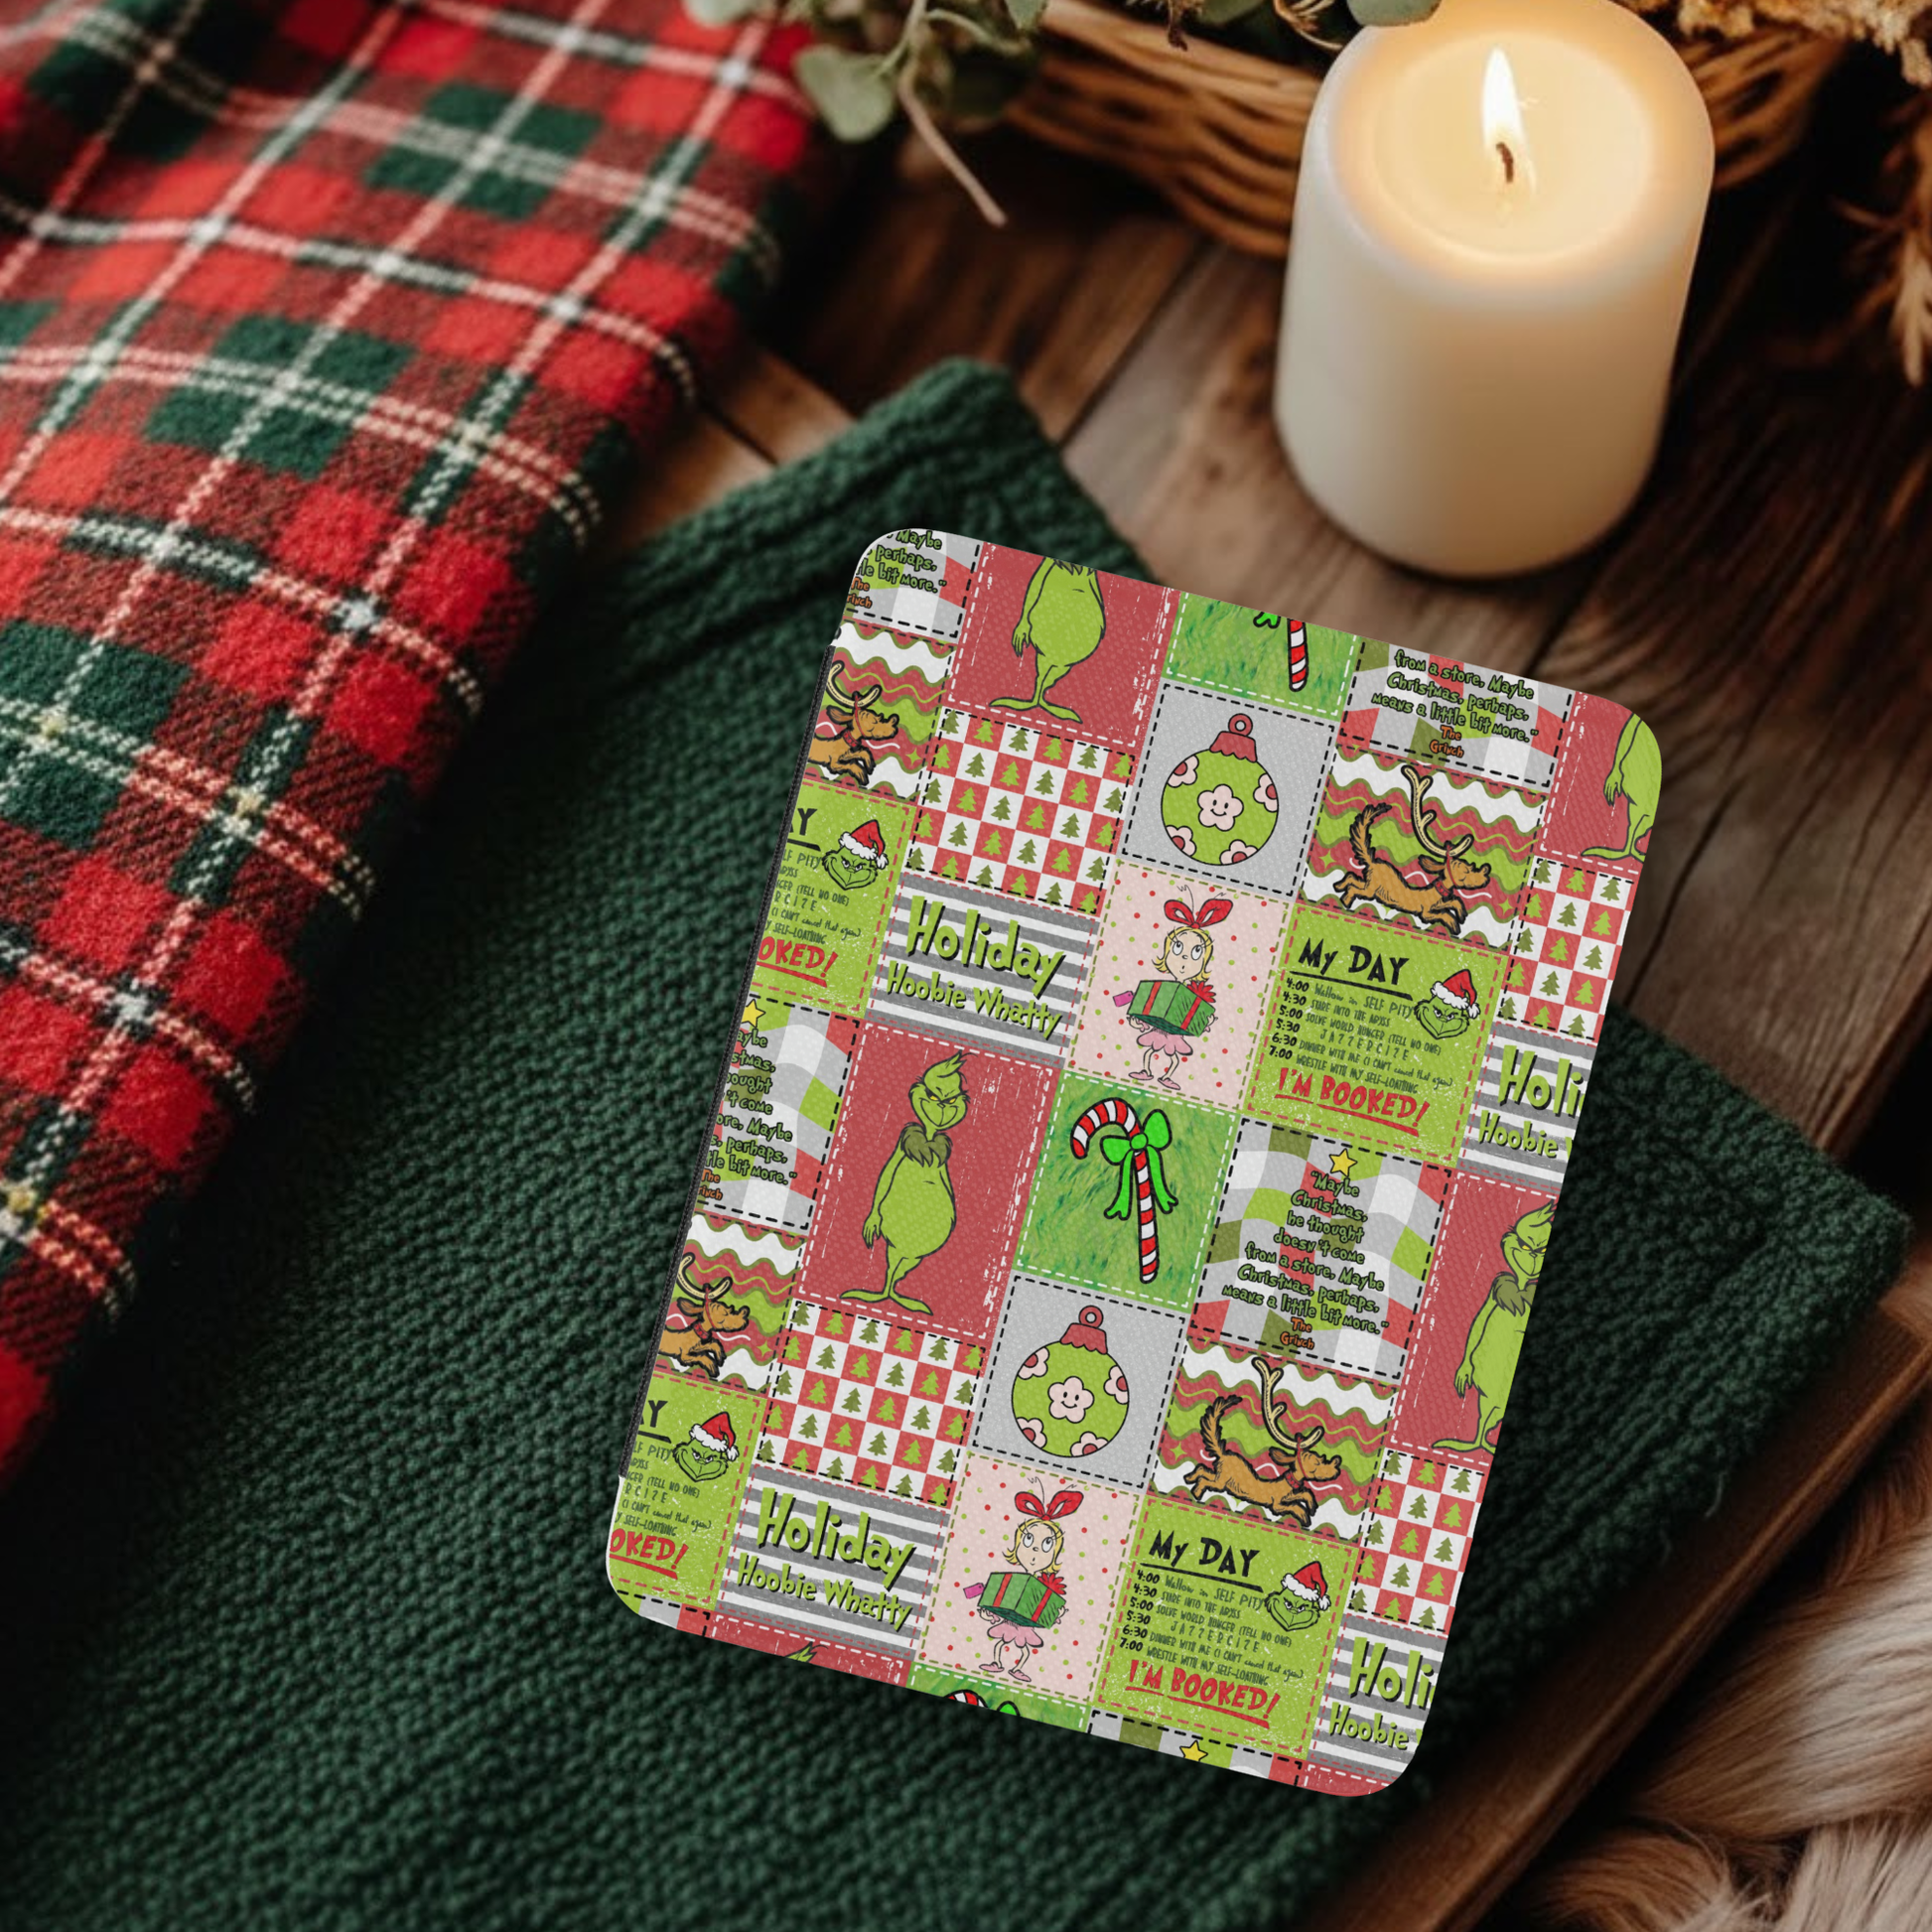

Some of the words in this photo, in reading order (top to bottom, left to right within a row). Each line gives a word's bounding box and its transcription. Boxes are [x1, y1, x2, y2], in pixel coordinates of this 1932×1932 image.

[896, 529, 942, 550] Maybe
[878, 563, 899, 584] bit
[1429, 663, 1439, 675] a
[1442, 664, 1484, 688] store,
[1488, 675, 1534, 699] Maybe
[1417, 704, 1427, 717] a
[1431, 702, 1465, 726] little
[1470, 712, 1492, 734] bit
[1468, 694, 1529, 721] perhaps,
[1441, 726, 1461, 741] The
[797, 853, 821, 870] PITY
[818, 890, 829, 901] NO
[758, 936, 839, 978] OKED!
[905, 896, 1066, 1000] Holiday
[1348, 945, 1410, 985] DAY
[887, 960, 966, 1009] Hoobie
[973, 987, 1062, 1040] Whatty
[1283, 991, 1307, 1006] 4:30
[1333, 1006, 1350, 1018] INTO
[1354, 1010, 1367, 1024] THE
[1287, 977, 1310, 992] 4:00
[1363, 995, 1384, 1011] SELF
[1389, 1002, 1414, 1019] PITY
[736, 1028, 768, 1047] aybe
[1276, 1020, 1301, 1034] 5:30
[1279, 1006, 1303, 1020] 5:00
[1306, 1012, 1326, 1027] SOLVE
[1329, 1017, 1353, 1034] WORLD
[1411, 1038, 1421, 1050] NO
[1269, 1045, 1293, 1059] 7:00
[1296, 1053, 1327, 1071] WRESTLE
[1272, 1033, 1297, 1046] 6:30
[1299, 1040, 1326, 1056] DINNER
[1348, 1051, 1360, 1064] ME
[1279, 1067, 1312, 1098] I'M
[1320, 1074, 1430, 1127] BOOKED!
[1497, 1044, 1585, 1118] Holi
[747, 1118, 793, 1142] Maybe
[1478, 1110, 1559, 1158] Hoobie
[726, 1137, 788, 1164] perhaps,
[729, 1159, 750, 1179] bit
[1287, 1210, 1304, 1227] he
[1309, 1215, 1364, 1242] thought
[1279, 1255, 1289, 1267] a
[1292, 1258, 1335, 1280] store,
[1339, 1267, 1384, 1291] Maybe
[1267, 1297, 1277, 1309] a
[1282, 1294, 1316, 1318] little
[1321, 1305, 1341, 1325] bit
[1318, 1287, 1380, 1312] perhaps,
[1292, 1317, 1312, 1332] The
[647, 1445, 672, 1461] PITY
[669, 1481, 679, 1493] NO
[611, 1528, 689, 1570] OKED!
[757, 1487, 916, 1591] Holiday
[1199, 1537, 1260, 1578] DAY
[738, 1552, 817, 1600] Hoobie
[824, 1579, 912, 1632] Whatty
[1134, 1584, 1157, 1598] 4:30
[1184, 1598, 1200, 1610] INTO
[1204, 1601, 1217, 1615] THE
[1137, 1570, 1160, 1585] 4:00
[1214, 1587, 1235, 1603] SELF
[1240, 1594, 1264, 1611] PITY
[1127, 1611, 1151, 1625] 5:30
[1130, 1597, 1154, 1611] 5:00
[1156, 1604, 1177, 1619] SOLVE
[1180, 1609, 1204, 1625] WORLD
[1261, 1630, 1272, 1642] NO
[1119, 1637, 1143, 1652] 7:00
[1147, 1646, 1177, 1664] WRESTLE
[1122, 1625, 1148, 1639] 6:30
[1150, 1632, 1176, 1648] DINNER
[1199, 1644, 1210, 1656] ME
[1130, 1659, 1164, 1690] I'M
[1171, 1667, 1281, 1720] BOOKED!
[1348, 1637, 1436, 1711] Holi
[1329, 1702, 1409, 1750] Hoobie
